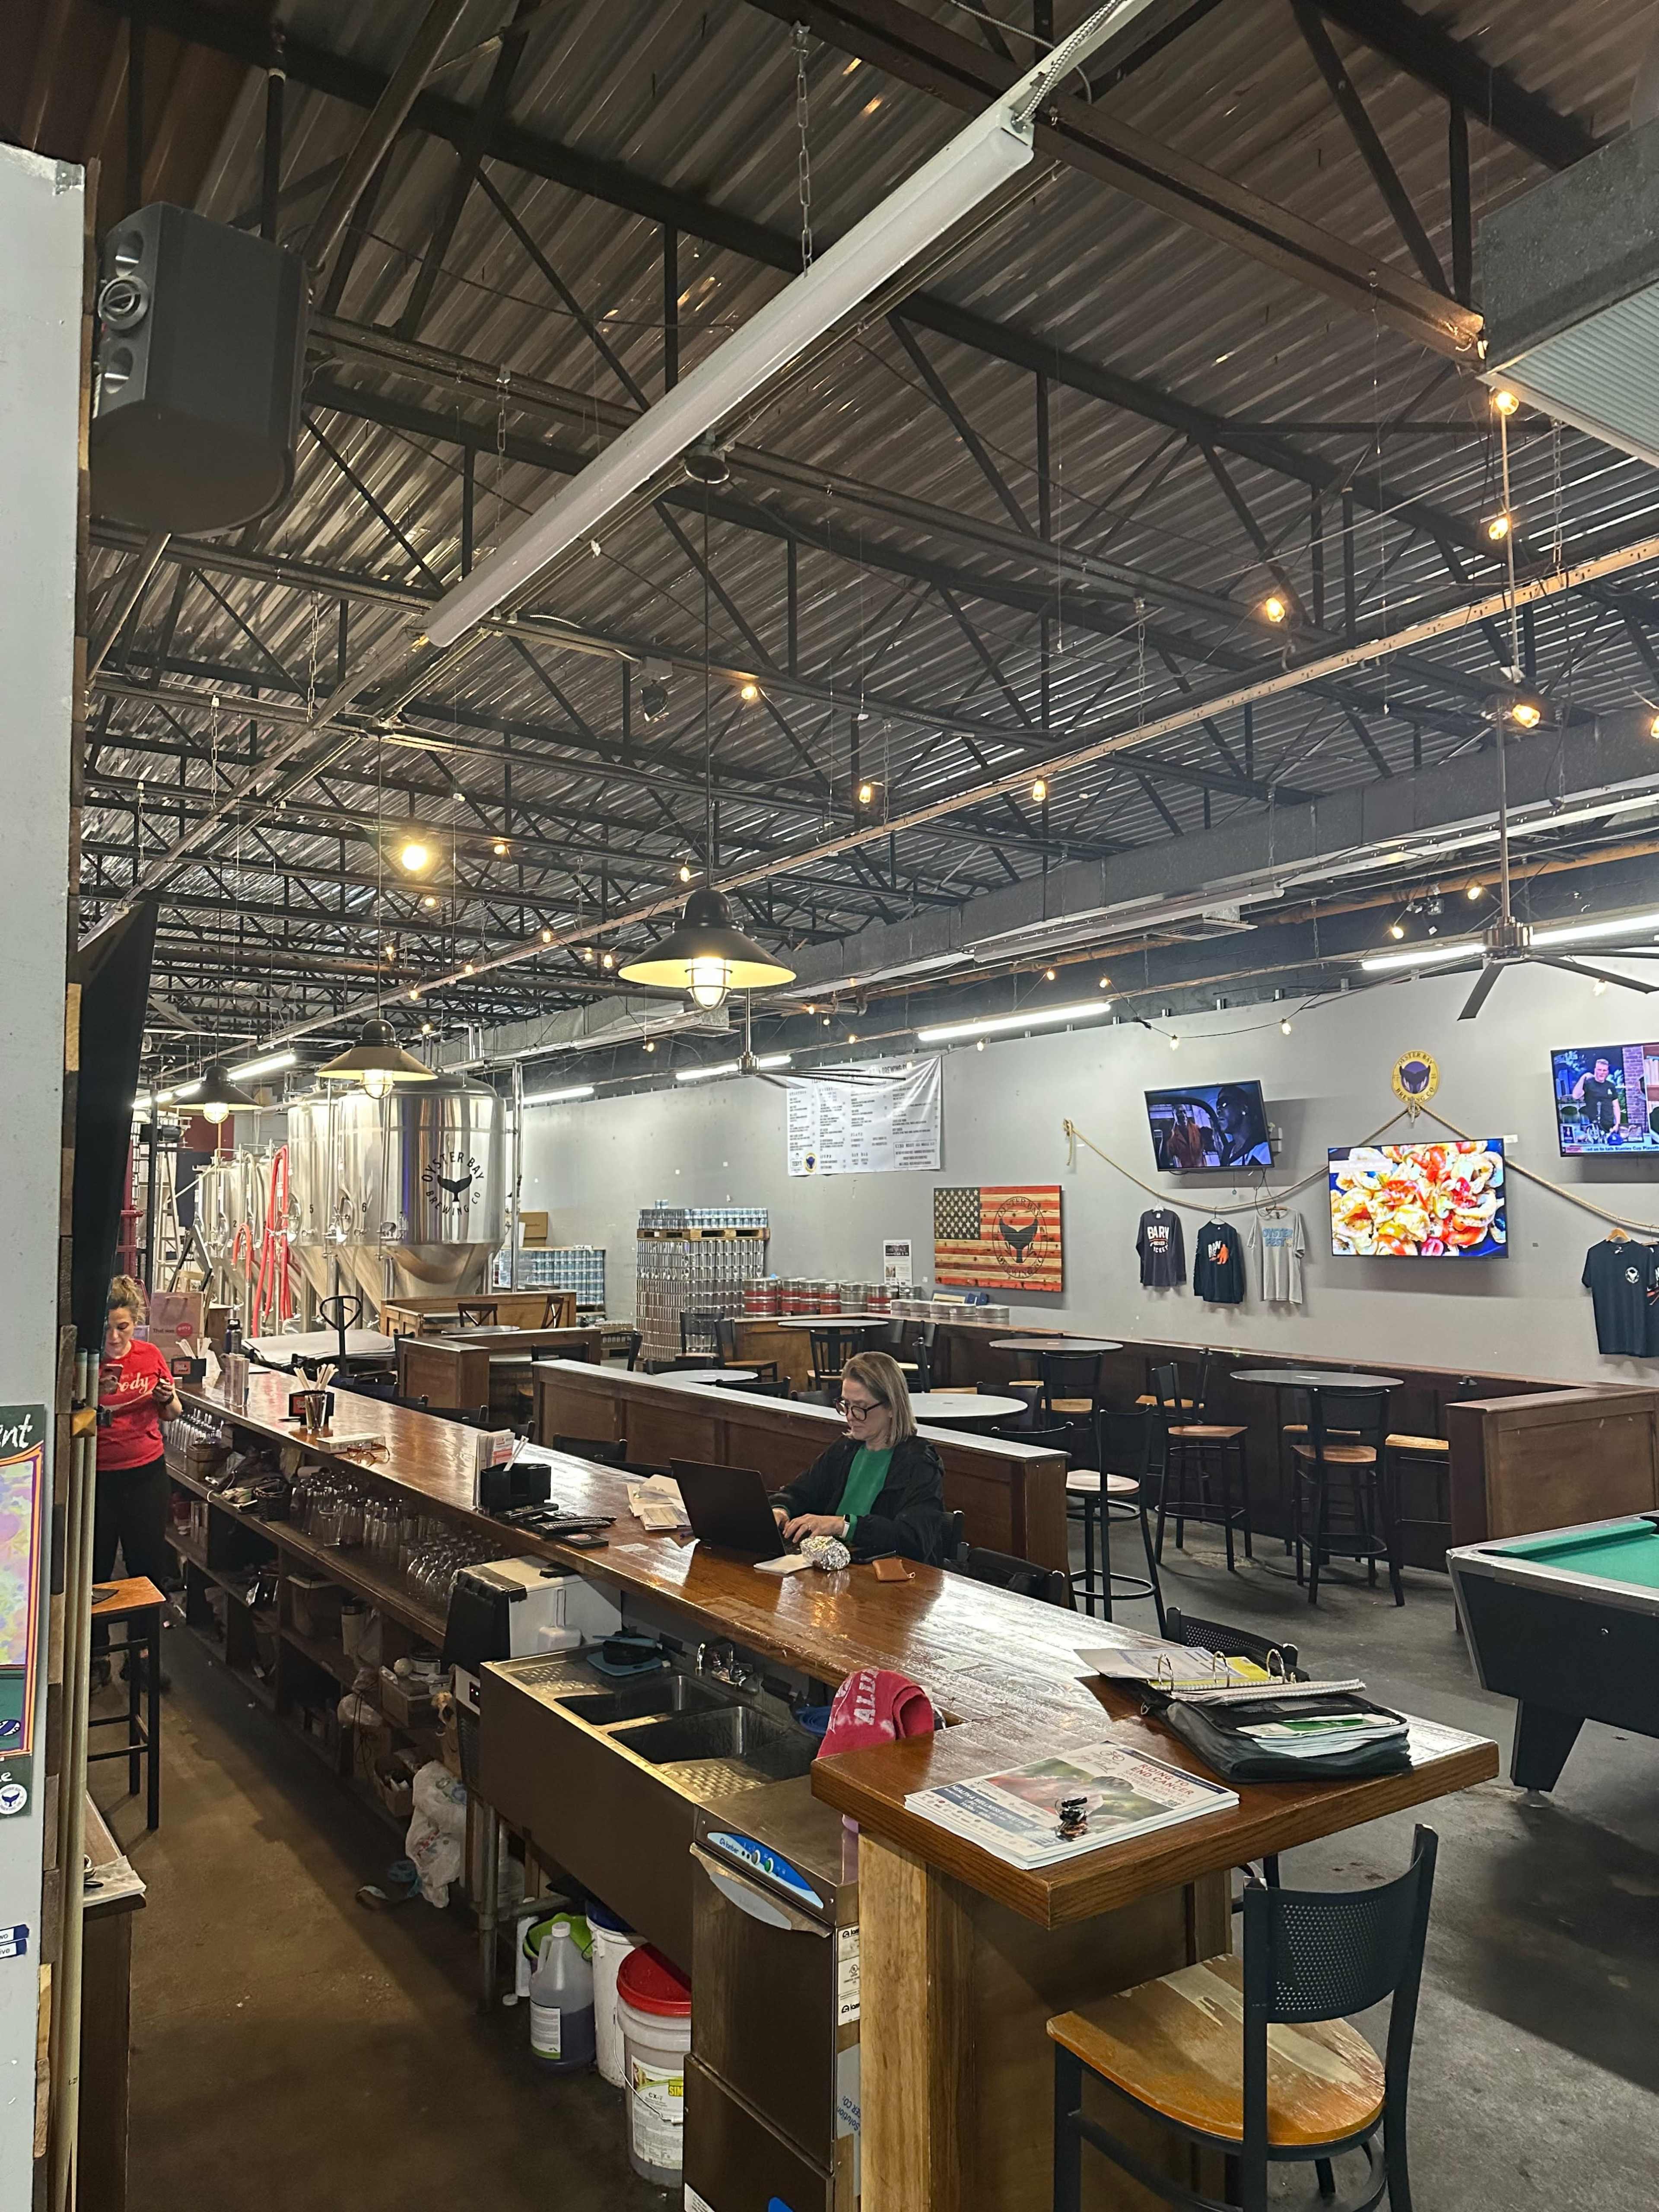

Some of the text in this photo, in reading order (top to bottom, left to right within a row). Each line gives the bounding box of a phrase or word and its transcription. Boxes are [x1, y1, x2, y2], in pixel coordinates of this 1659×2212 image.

[1398, 1052, 1433, 1065] OYSTER BAY
[1396, 1088, 1425, 1102] BREWNG
[422, 1152, 484, 1182] OYSTER BAY
[309, 1204, 314, 1214] 5
[362, 1202, 367, 1212] 6
[426, 1190, 480, 1216] BREWING CO
[997, 1198, 1027, 1217] OYSTER
[1262, 1228, 1294, 1238] OYSTER
[1265, 1237, 1286, 1247] FEST
[118, 1372, 149, 1394] ody
[1138, 1764, 1174, 1780] RIDING
[1129, 1767, 1153, 1778] END
[1152, 1777, 1195, 1796] CANCER
[951, 1786, 971, 1798] HEALTH
[973, 1798, 1003, 1813] WELLNESS
[669, 2086, 683, 2096] SIM
